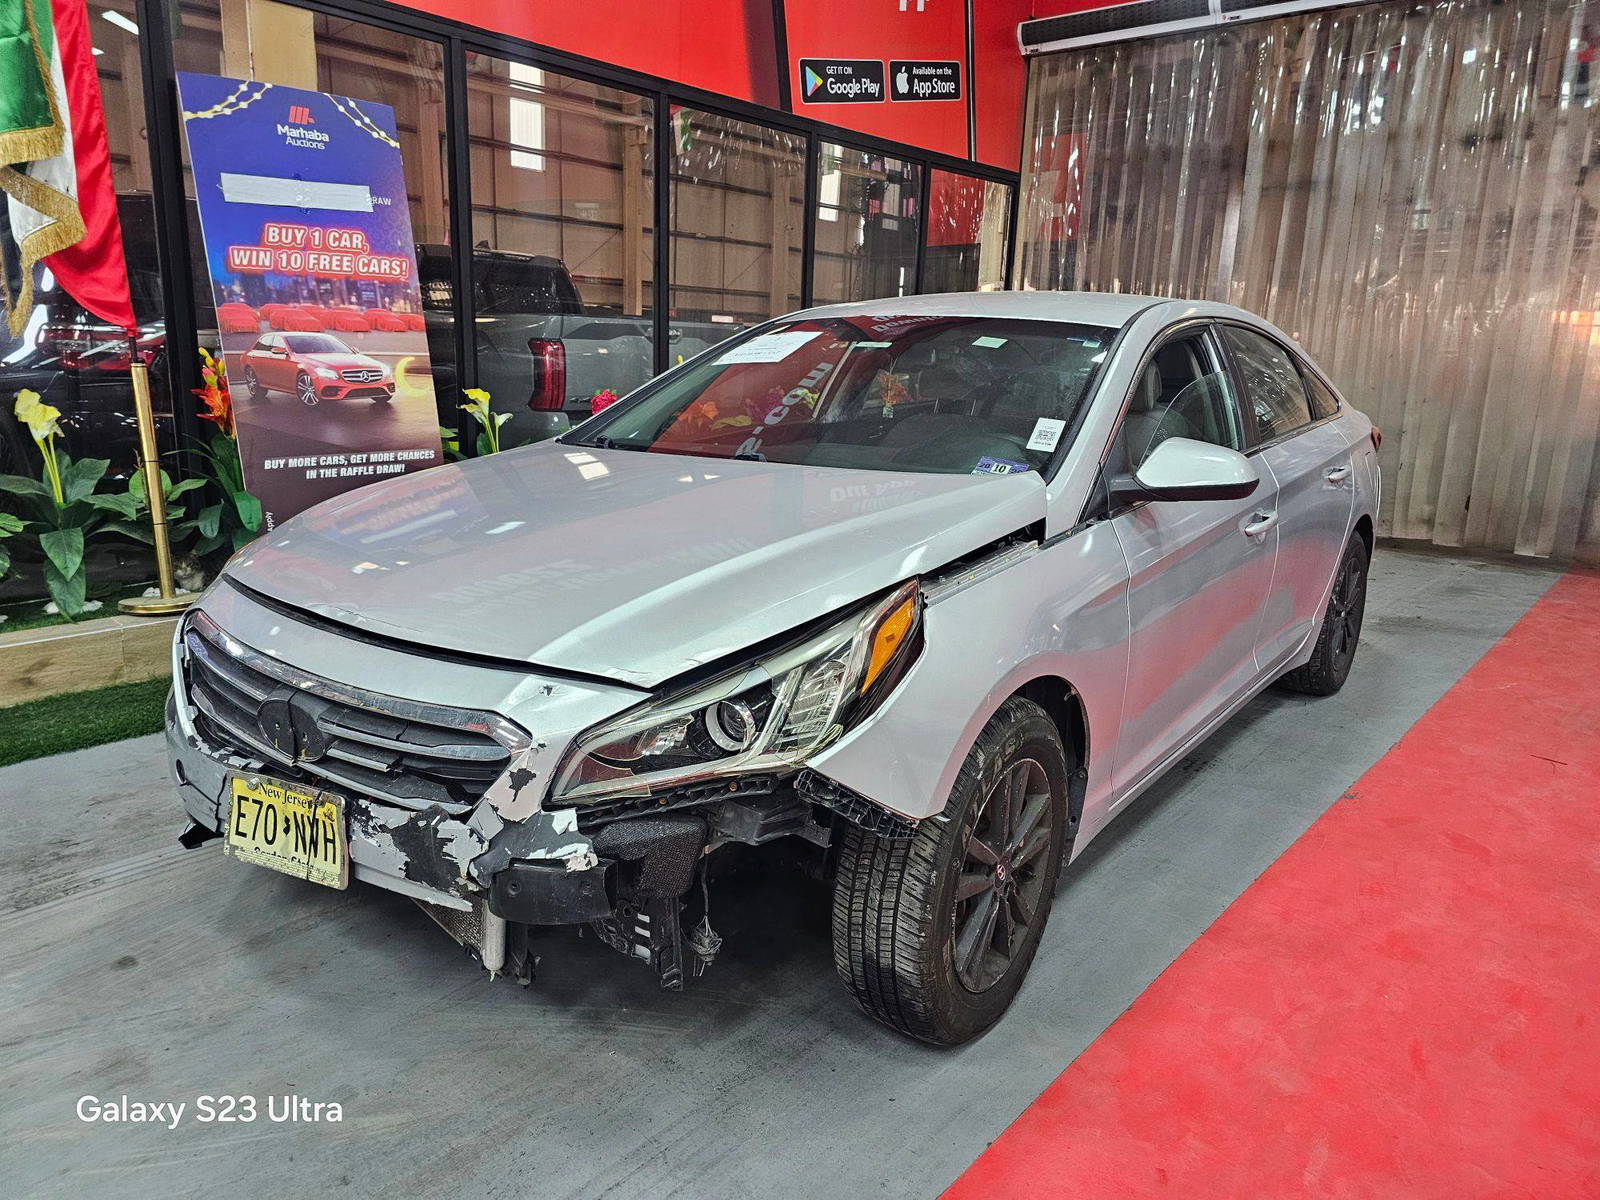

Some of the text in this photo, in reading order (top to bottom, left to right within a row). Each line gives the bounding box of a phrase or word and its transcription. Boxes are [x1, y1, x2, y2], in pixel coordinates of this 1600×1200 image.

[826, 65, 853, 75] GET IT ON
[912, 66, 936, 75] Available
[943, 67, 952, 75] the
[826, 78, 880, 98] Google Play
[913, 79, 955, 97] App Store
[276, 123, 329, 143] Marhaba
[285, 136, 326, 150] Auctions
[267, 225, 369, 254] BUY 1 CAR,
[232, 248, 408, 277] WIN 10 FREE CARS!
[264, 450, 435, 470] BUY MORE CARS, GET MORE CHANCES
[993, 464, 1007, 473] 10
[305, 464, 405, 480] IN THE RAFFLE DRAW!
[258, 782, 282, 801] New
[235, 795, 278, 846] E70
